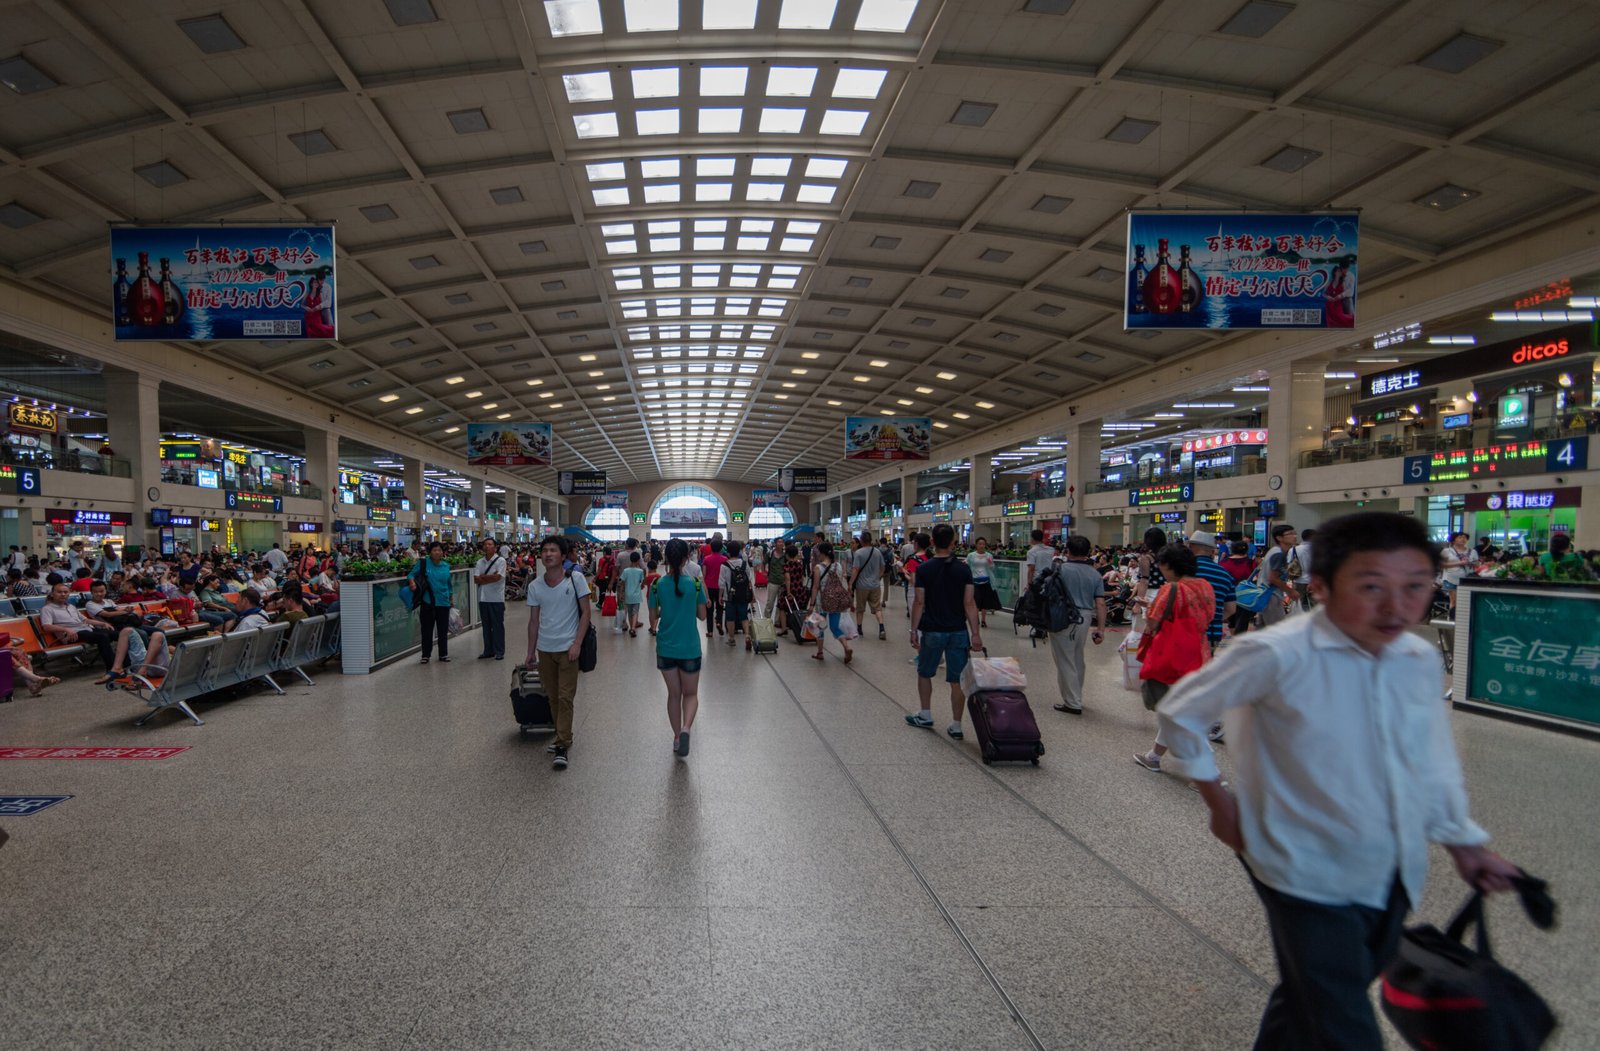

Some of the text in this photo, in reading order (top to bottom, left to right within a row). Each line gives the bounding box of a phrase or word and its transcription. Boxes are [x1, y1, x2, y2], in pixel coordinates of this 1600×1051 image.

[1205, 234, 1344, 253] 百年枝江 百年好合
[184, 246, 320, 265] 百年枝江 百年好合
[1205, 274, 1326, 297] 情定马尔代夫
[187, 286, 304, 309] 情定马尔代夫
[1512, 340, 1569, 364] dicos
[1371, 372, 1420, 395] 德克士
[1556, 444, 1574, 465] 4
[1411, 461, 1423, 477] 5
[24, 472, 34, 489] 5
[229, 494, 235, 506] 6
[1131, 492, 1137, 503] 7
[1183, 486, 1190, 498] 6
[275, 499, 281, 510] 7
